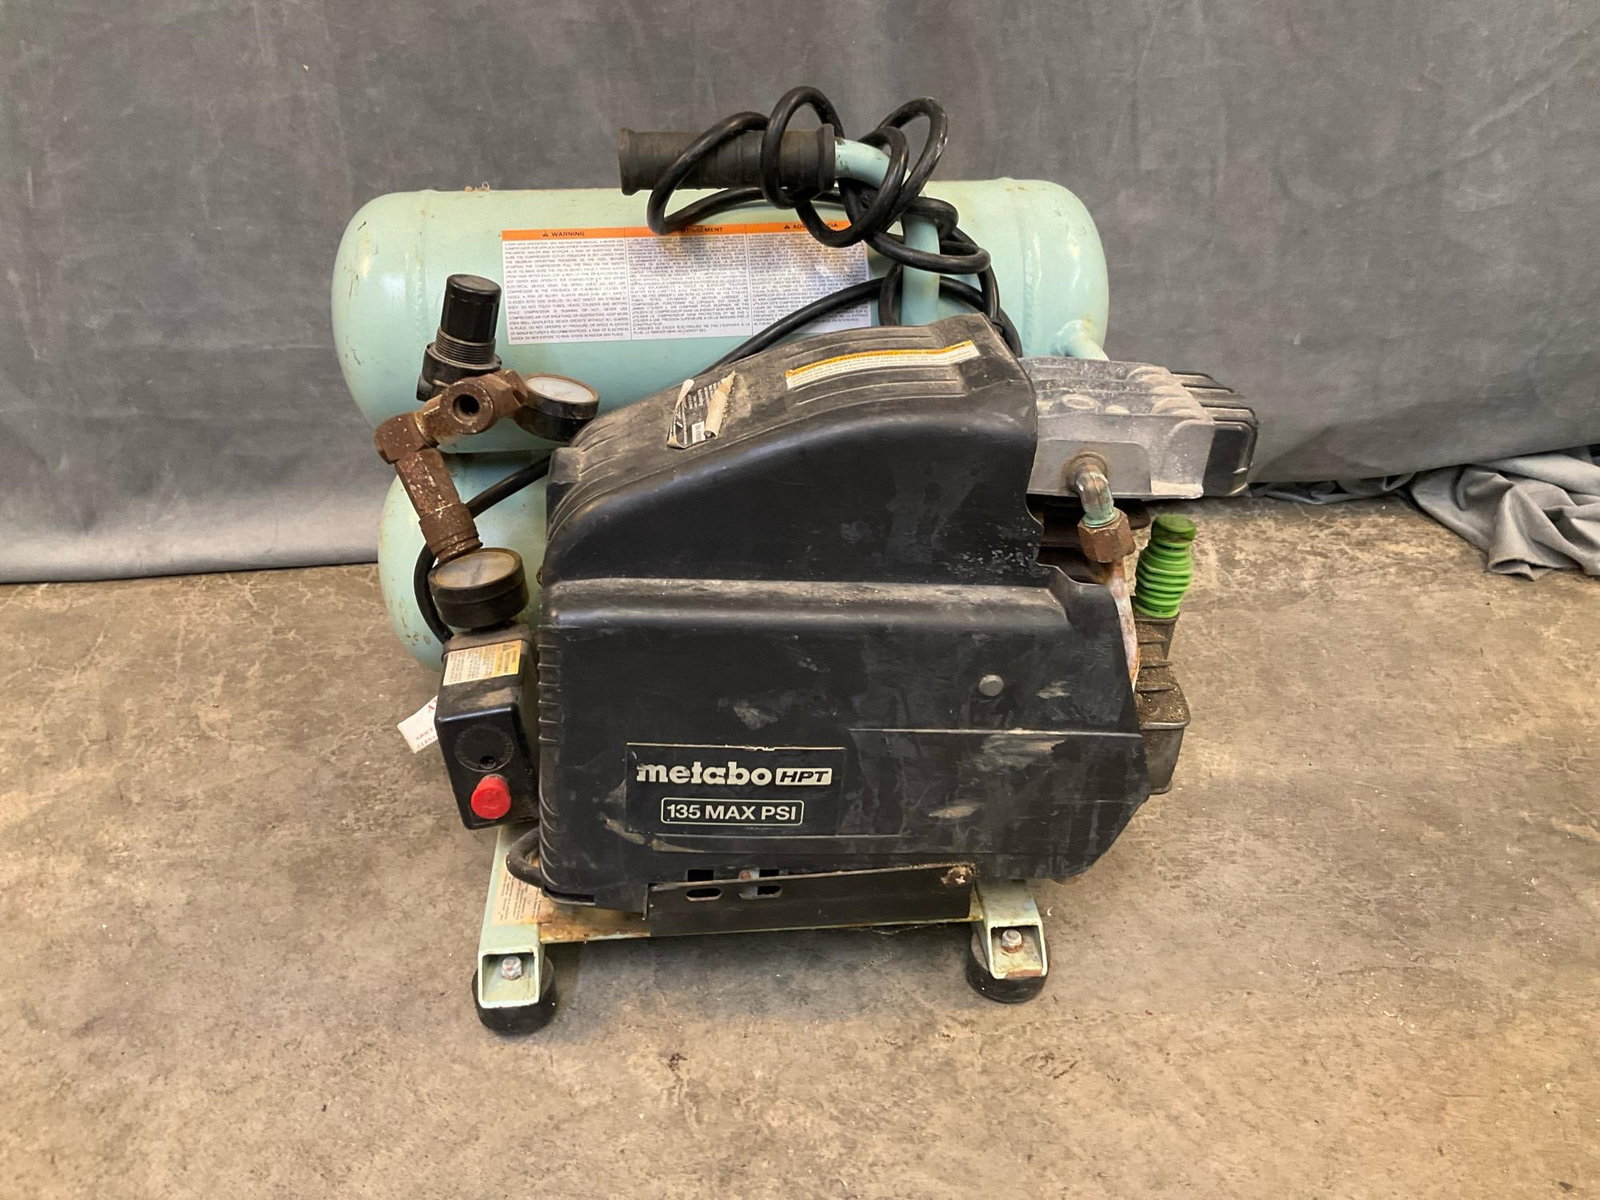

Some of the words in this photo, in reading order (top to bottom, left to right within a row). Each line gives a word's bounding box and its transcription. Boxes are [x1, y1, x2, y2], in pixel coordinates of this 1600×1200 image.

[636, 761, 772, 785] metabo
[778, 770, 830, 783] HPT
[667, 804, 701, 819] 135
[705, 805, 757, 820] MAX
[761, 806, 797, 821] PSI
